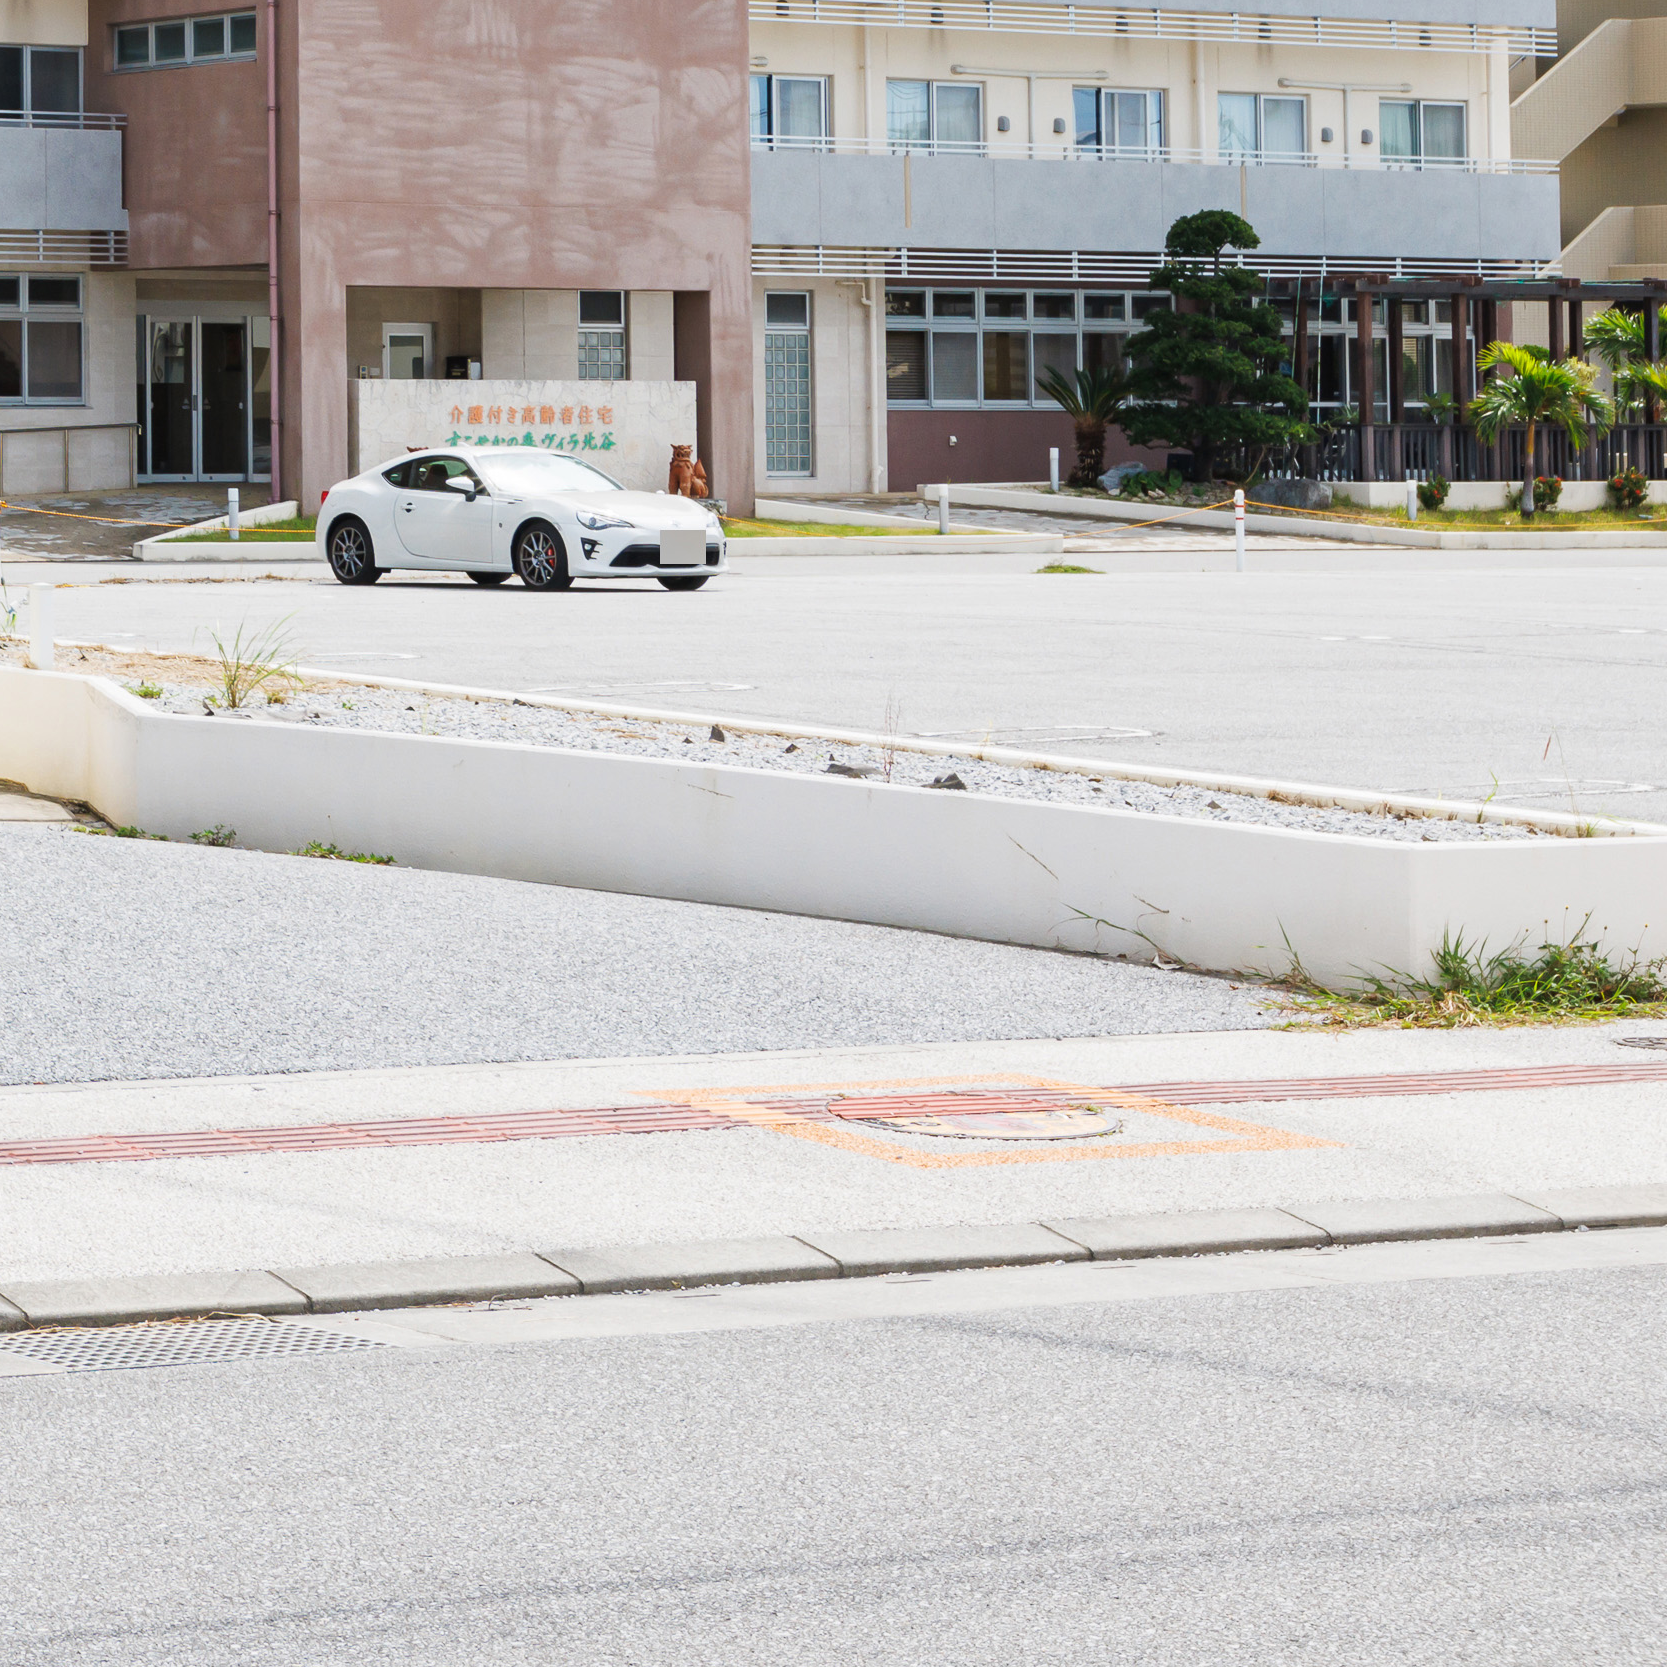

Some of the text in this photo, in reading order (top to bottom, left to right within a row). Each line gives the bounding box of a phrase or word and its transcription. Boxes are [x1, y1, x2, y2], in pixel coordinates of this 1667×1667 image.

[449, 404, 614, 426] 介護付き高齢者住宅
